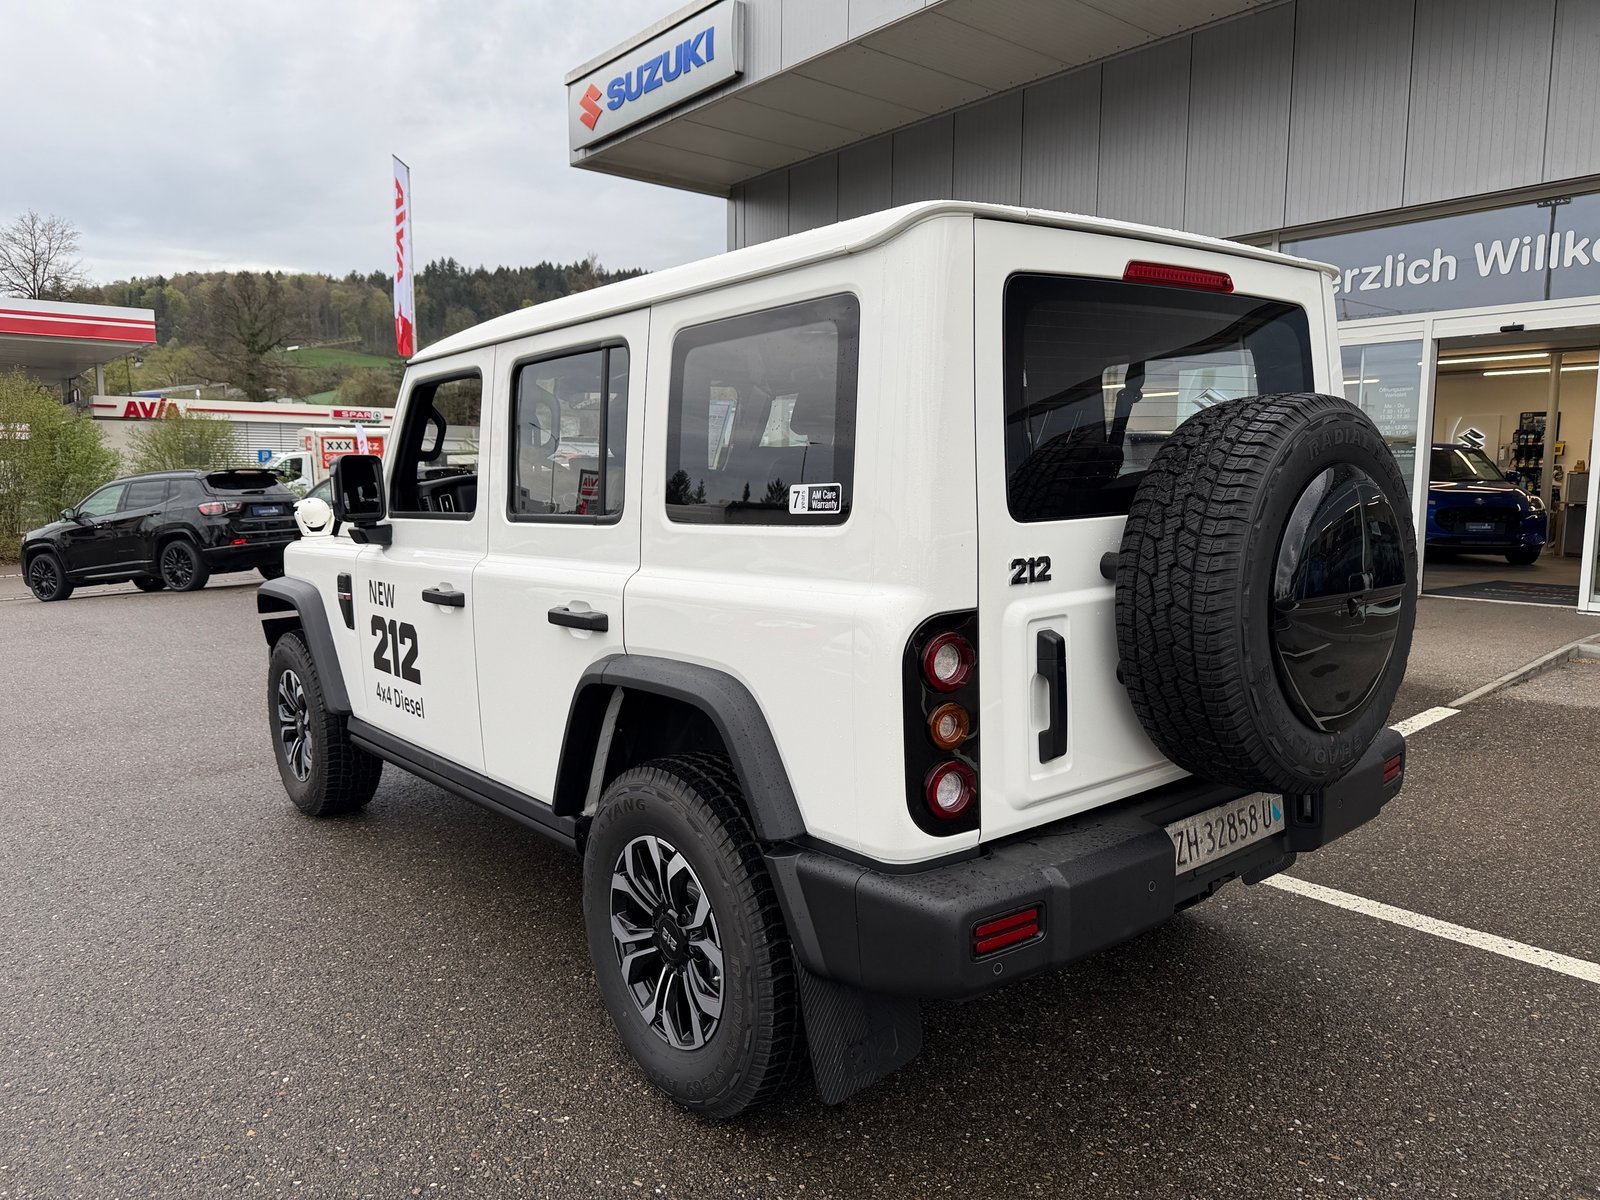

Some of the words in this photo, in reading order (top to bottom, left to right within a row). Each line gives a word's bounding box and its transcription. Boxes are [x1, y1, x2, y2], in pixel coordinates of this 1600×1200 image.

[606, 26, 715, 111] SUZUKI
[123, 398, 181, 420] AVIA
[341, 410, 372, 418] SPAR
[326, 441, 352, 450] XXX
[793, 490, 801, 509] 7
[811, 499, 838, 511] Warranty
[812, 490, 822, 500] AM
[822, 490, 837, 499] Care
[1009, 555, 1052, 586] 212
[368, 579, 395, 609] NEW
[371, 614, 422, 686] 212
[376, 682, 393, 705] 4x4
[393, 688, 425, 719] Diesel
